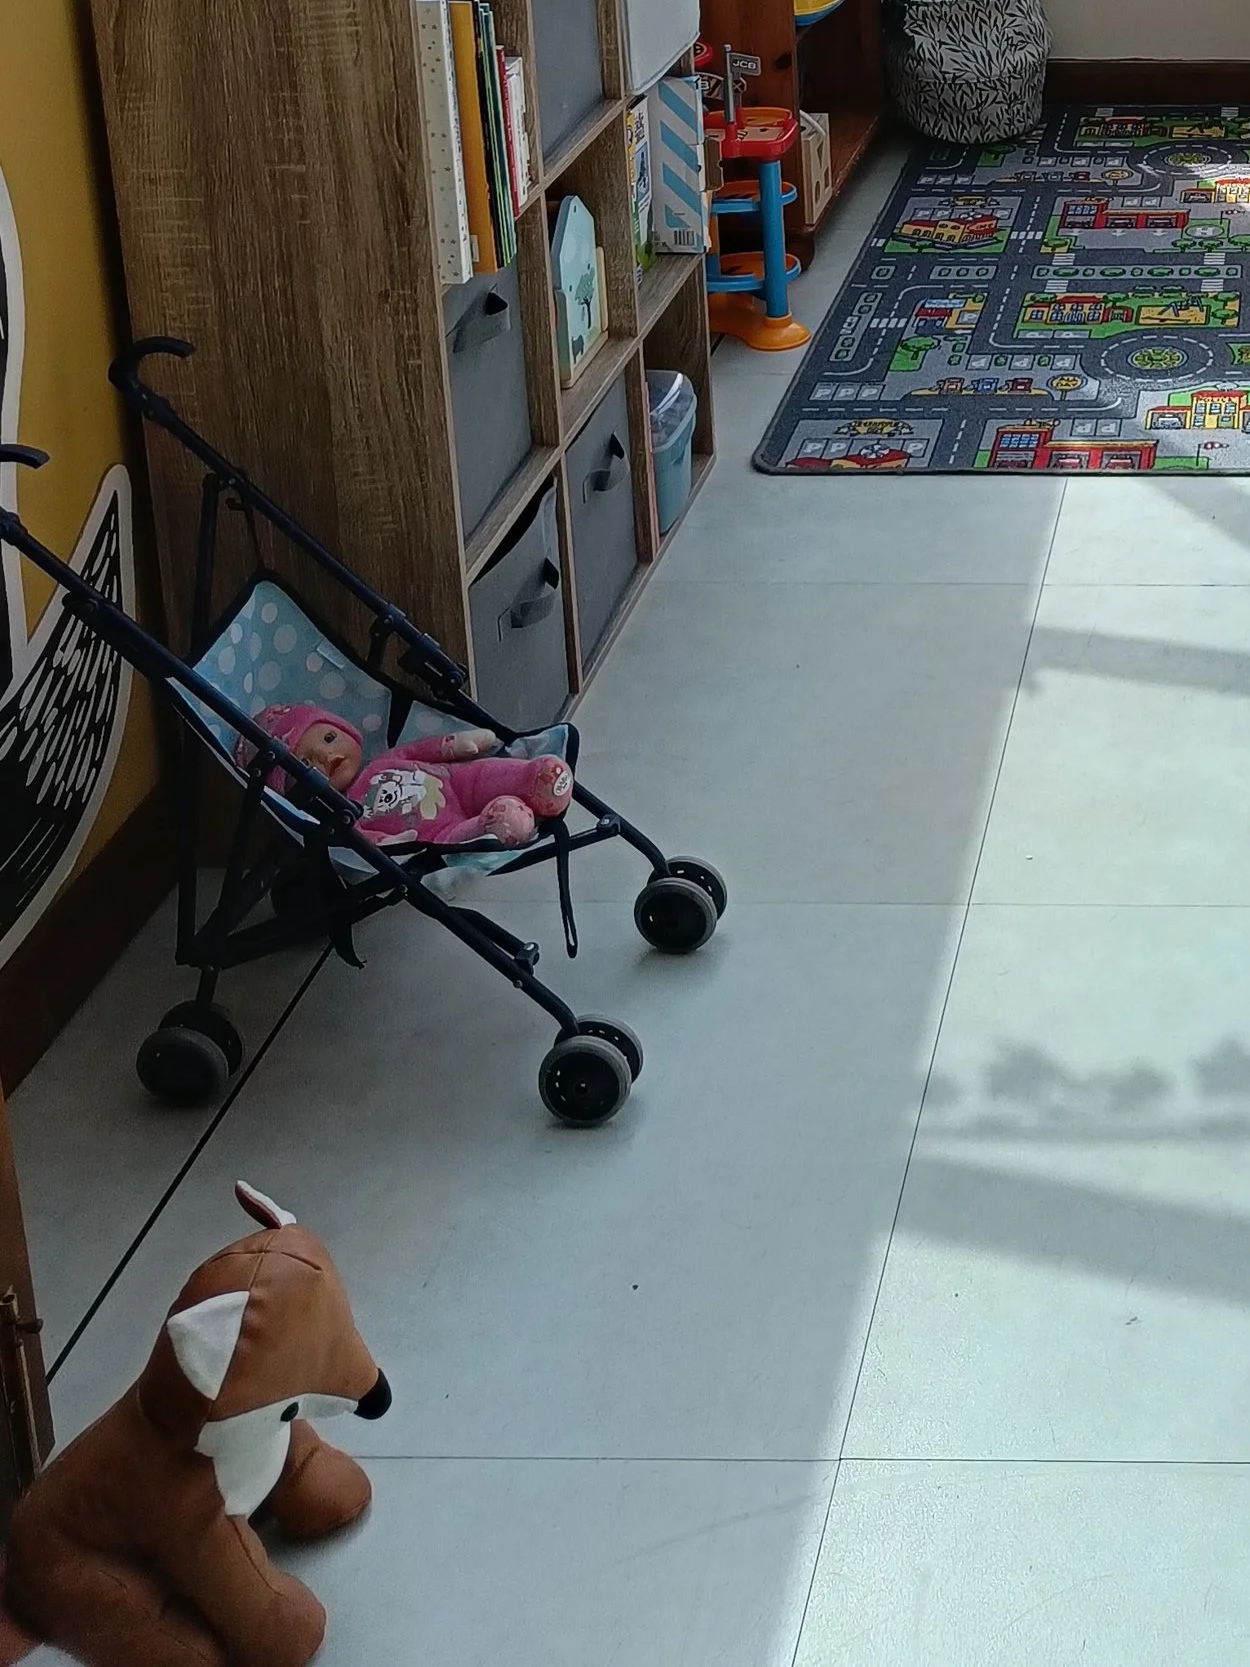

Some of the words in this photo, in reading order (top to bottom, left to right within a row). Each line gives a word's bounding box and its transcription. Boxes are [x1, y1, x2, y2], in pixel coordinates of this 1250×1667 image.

[732, 59, 757, 70] JCB
[803, 442, 823, 454] P
[829, 441, 847, 453] P
[907, 442, 924, 454] P
